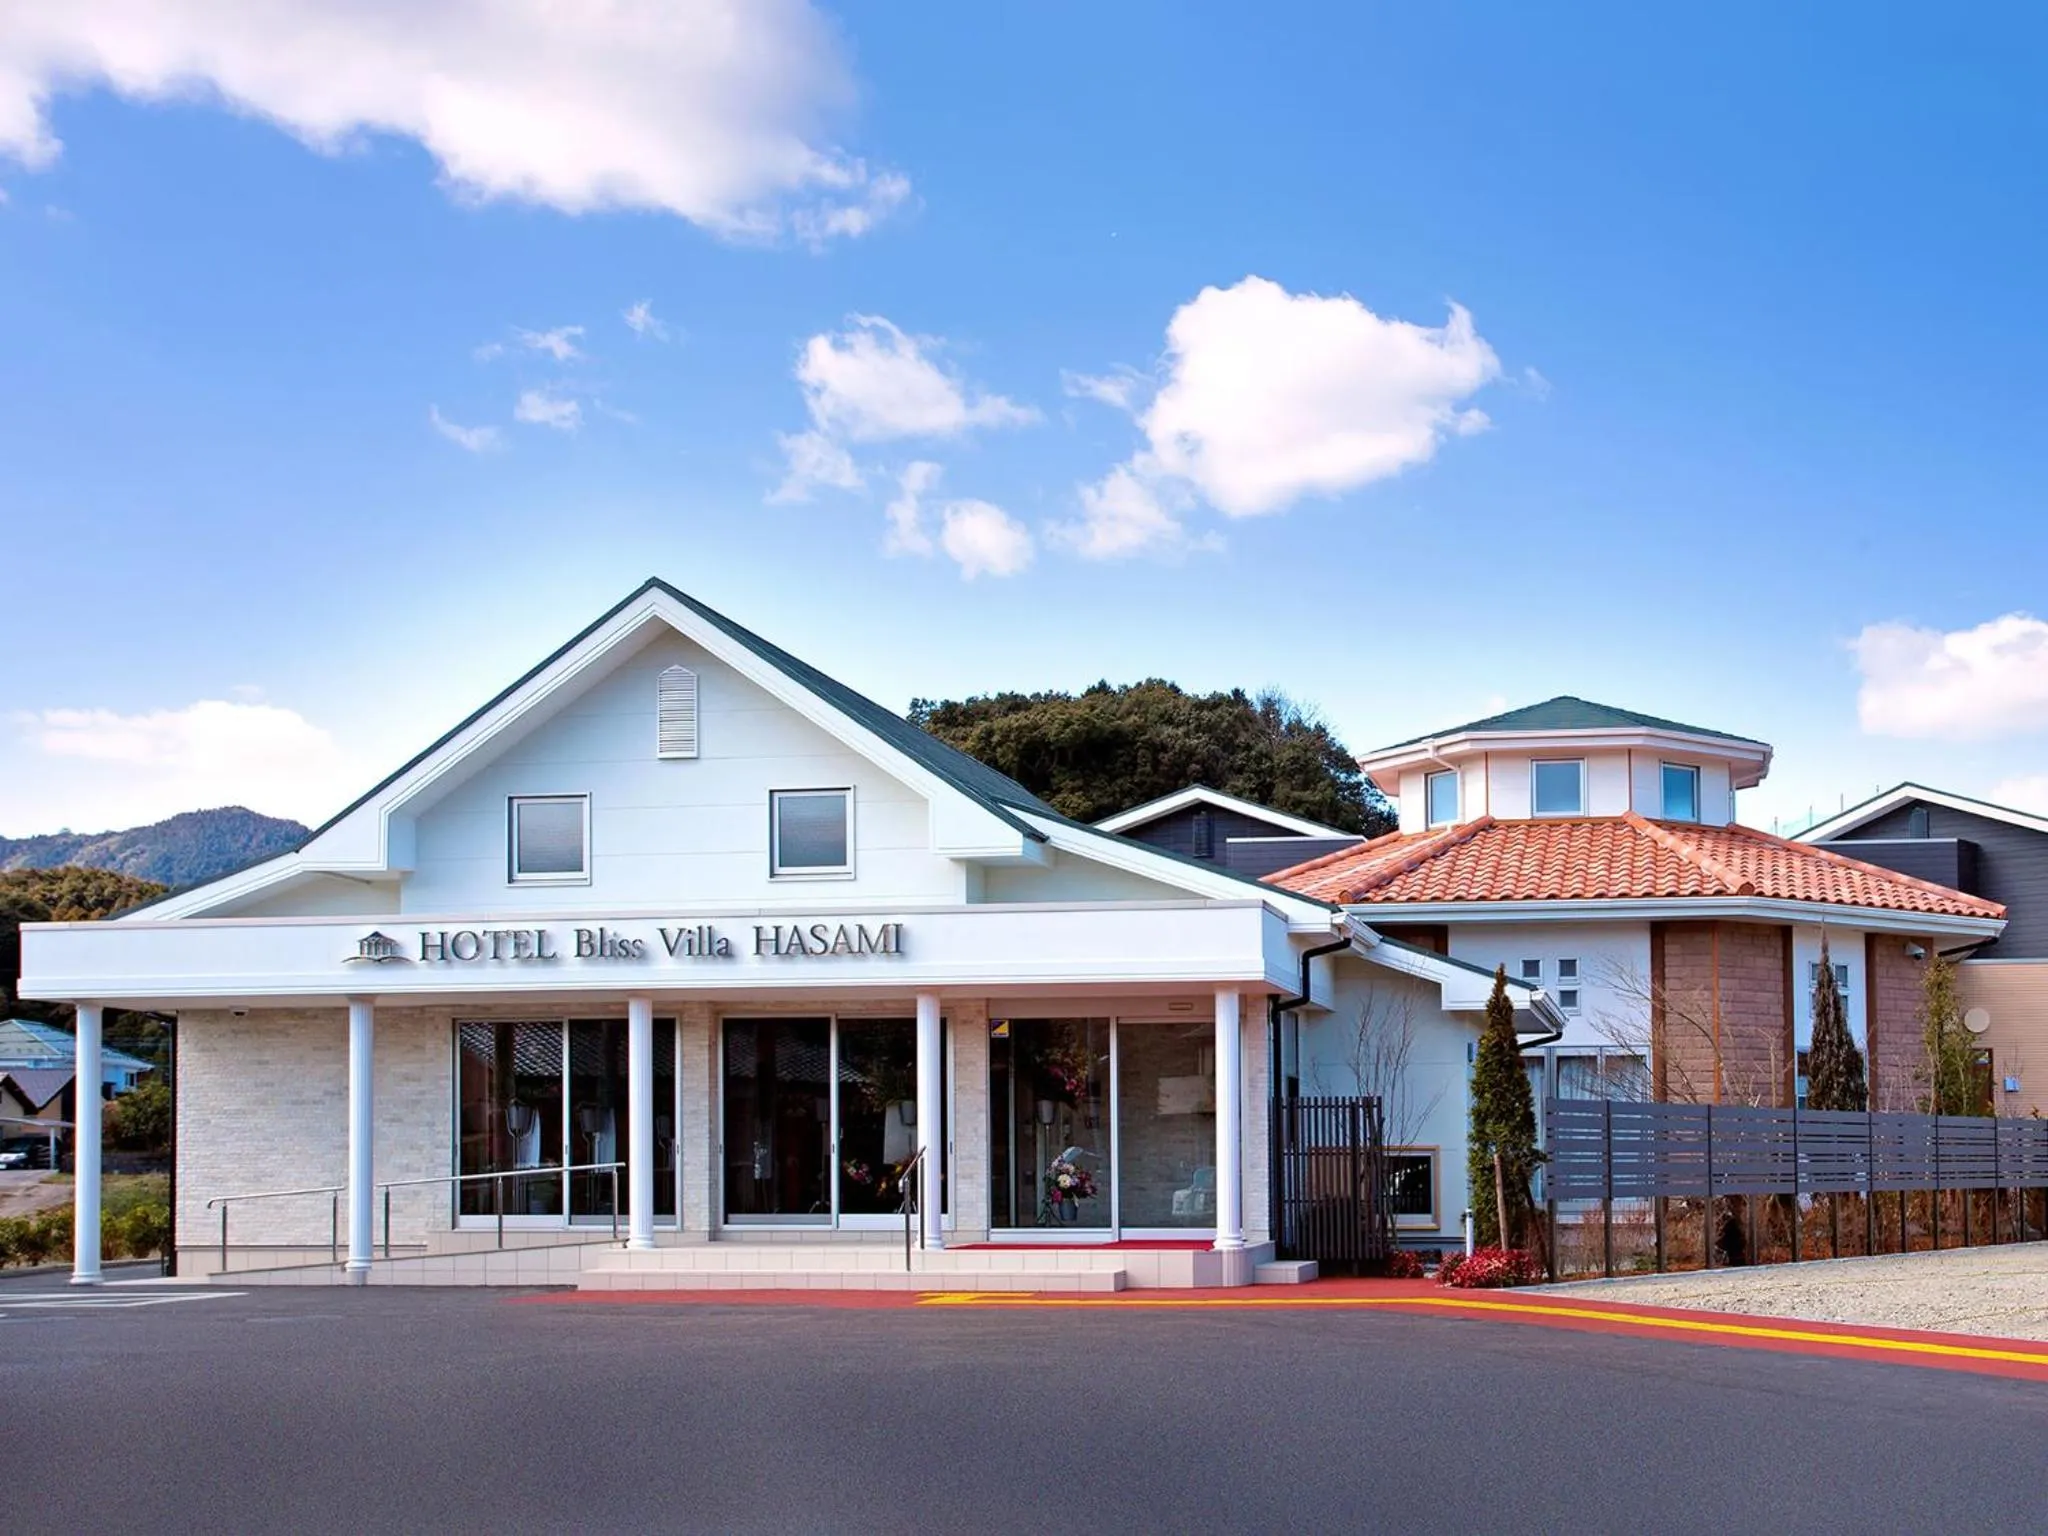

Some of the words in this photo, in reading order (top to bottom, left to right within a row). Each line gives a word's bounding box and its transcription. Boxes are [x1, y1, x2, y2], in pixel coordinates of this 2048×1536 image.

[419, 929, 557, 961] HOTEL
[574, 927, 643, 959] Bliss
[657, 925, 733, 957] Villa
[753, 923, 903, 956] HASAMI
